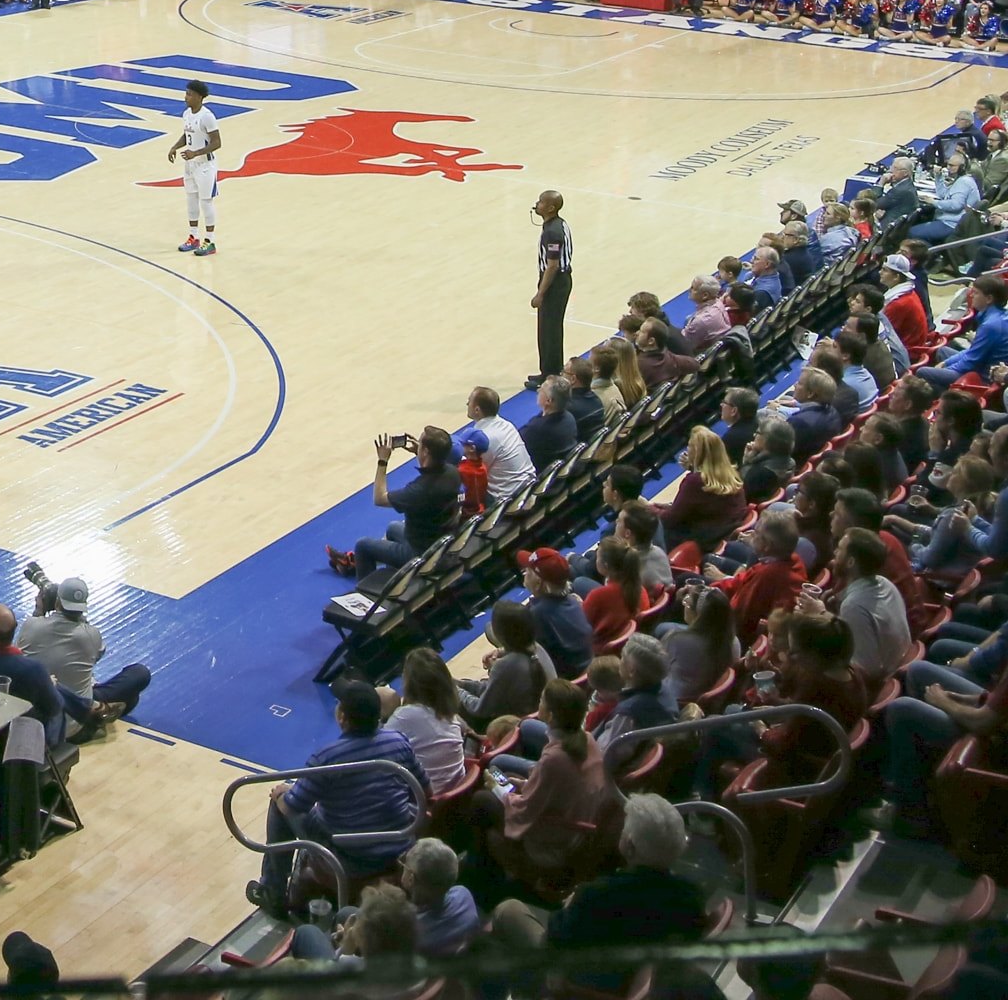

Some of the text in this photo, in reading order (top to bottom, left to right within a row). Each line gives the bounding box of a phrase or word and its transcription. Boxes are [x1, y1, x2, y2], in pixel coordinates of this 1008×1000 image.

[188, 134, 192, 145] 3
[648, 118, 794, 182] MOODY COLISEUM
[773, 134, 820, 157] TEXAS
[16, 382, 168, 448] AMERICAN
